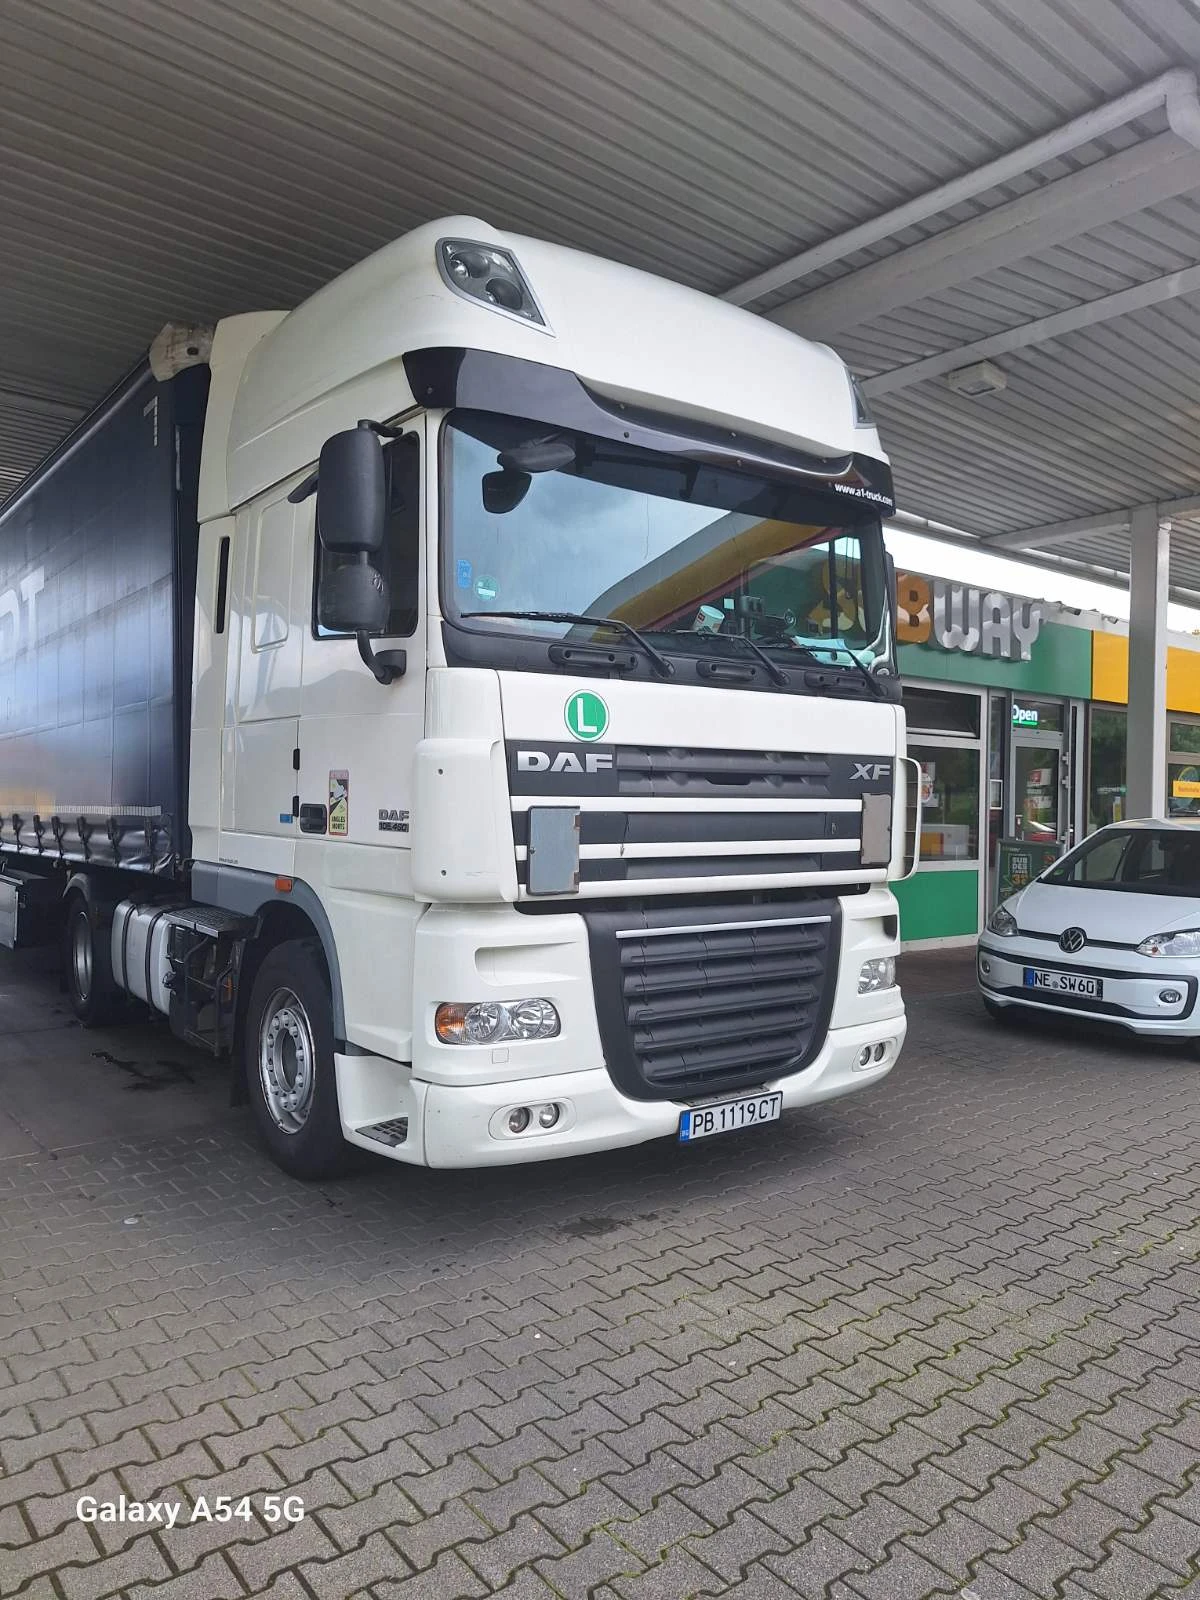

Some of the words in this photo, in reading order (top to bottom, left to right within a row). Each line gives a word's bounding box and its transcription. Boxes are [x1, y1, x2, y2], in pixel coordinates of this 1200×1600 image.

[577, 697, 598, 733] L
[517, 750, 613, 773] DAF
[849, 763, 891, 780] XF
[378, 809, 410, 822] DAF
[1034, 971, 1052, 988] NE
